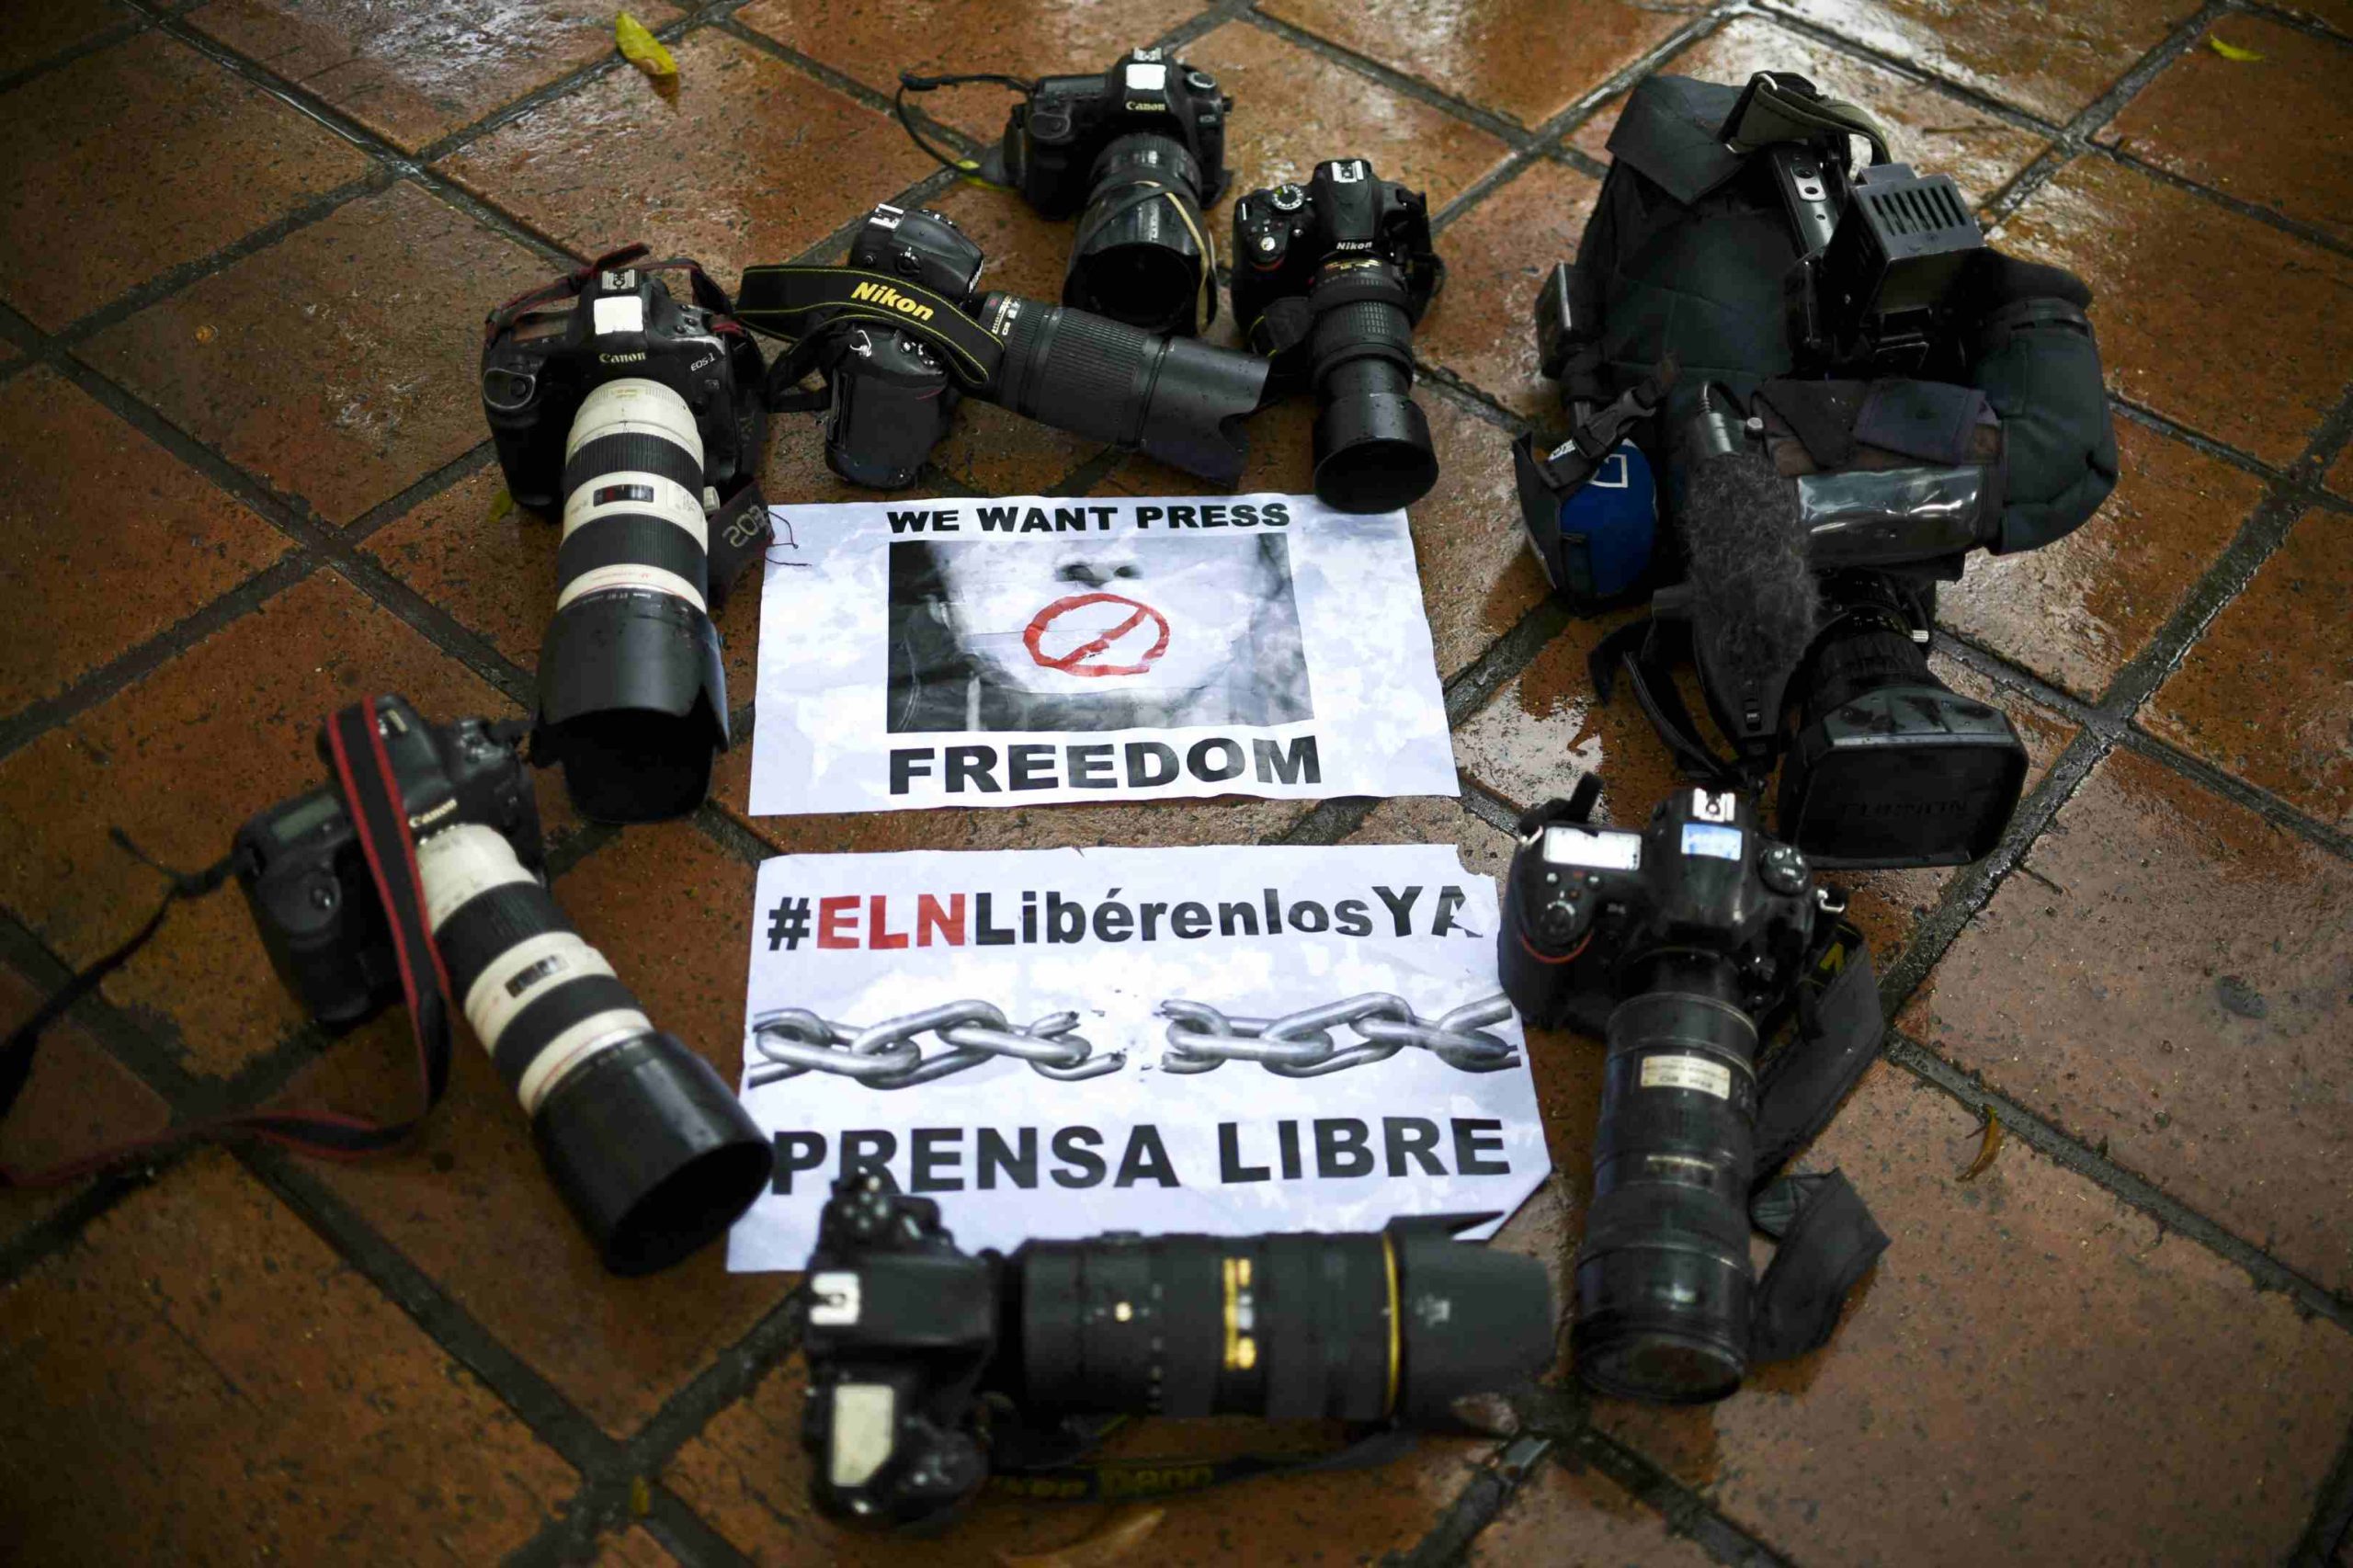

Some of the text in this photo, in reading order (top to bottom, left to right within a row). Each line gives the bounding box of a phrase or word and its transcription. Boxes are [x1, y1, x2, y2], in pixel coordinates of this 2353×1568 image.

[1336, 242, 1373, 250] Nikon
[850, 281, 934, 321] Nikon
[598, 352, 646, 364] Canon
[887, 502, 1290, 534] WE WANT PRESS
[888, 734, 1322, 796] FREEDOM
[770, 1116, 1511, 1196] PRENSA LIBRE
